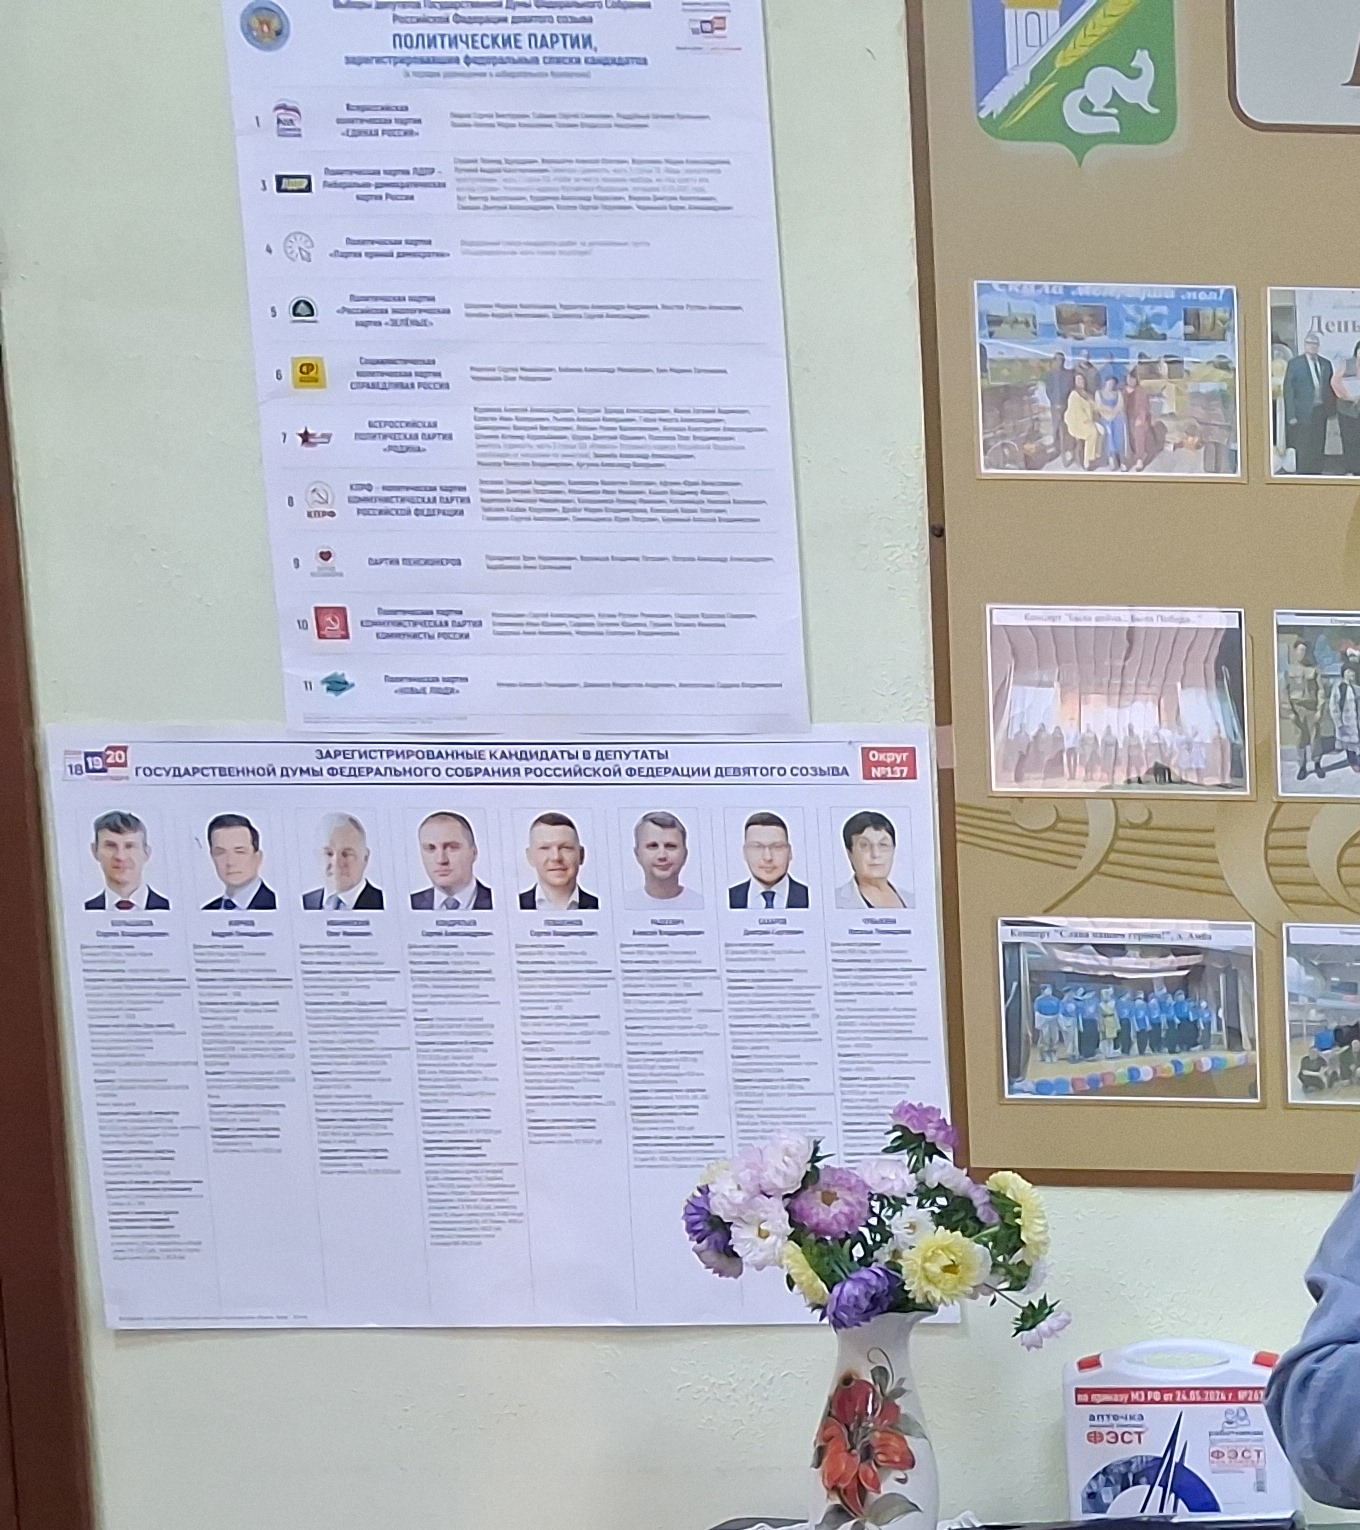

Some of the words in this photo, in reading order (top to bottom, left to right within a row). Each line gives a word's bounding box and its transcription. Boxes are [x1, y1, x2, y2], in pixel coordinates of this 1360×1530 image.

[392, 33, 522, 50] ПОЛИТИЧЕСКИЕ
[528, 33, 597, 52] ПАРТИИ,
[315, 749, 486, 761] ЗАРЕГИСТРИРОВАННЫЕ
[489, 750, 579, 762] КАНДИДАТЫ
[594, 750, 669, 762] ДЕПУТАТЫ
[868, 751, 909, 763] Округ
[67, 764, 83, 775] 18
[106, 751, 125, 764] 20
[135, 763, 276, 778] ГОСУДАРСТВЕННОЙ
[280, 766, 324, 780] ДУМЫ
[327, 766, 441, 779] ФЕДЕРАЛЬНОГО
[445, 766, 521, 778] СОБРАНИЯ
[525, 764, 622, 778] РОССИЙСКОЙ
[625, 766, 711, 779] ФЕДЕРАЦИИ
[714, 766, 786, 779] ДЕВЯТОГО
[790, 766, 849, 778] СОЗЫВА
[1148, 1390, 1161, 1401] РФ
[1089, 1413, 1144, 1423] аптечка
[1087, 1430, 1146, 1446] ФЭСТ
